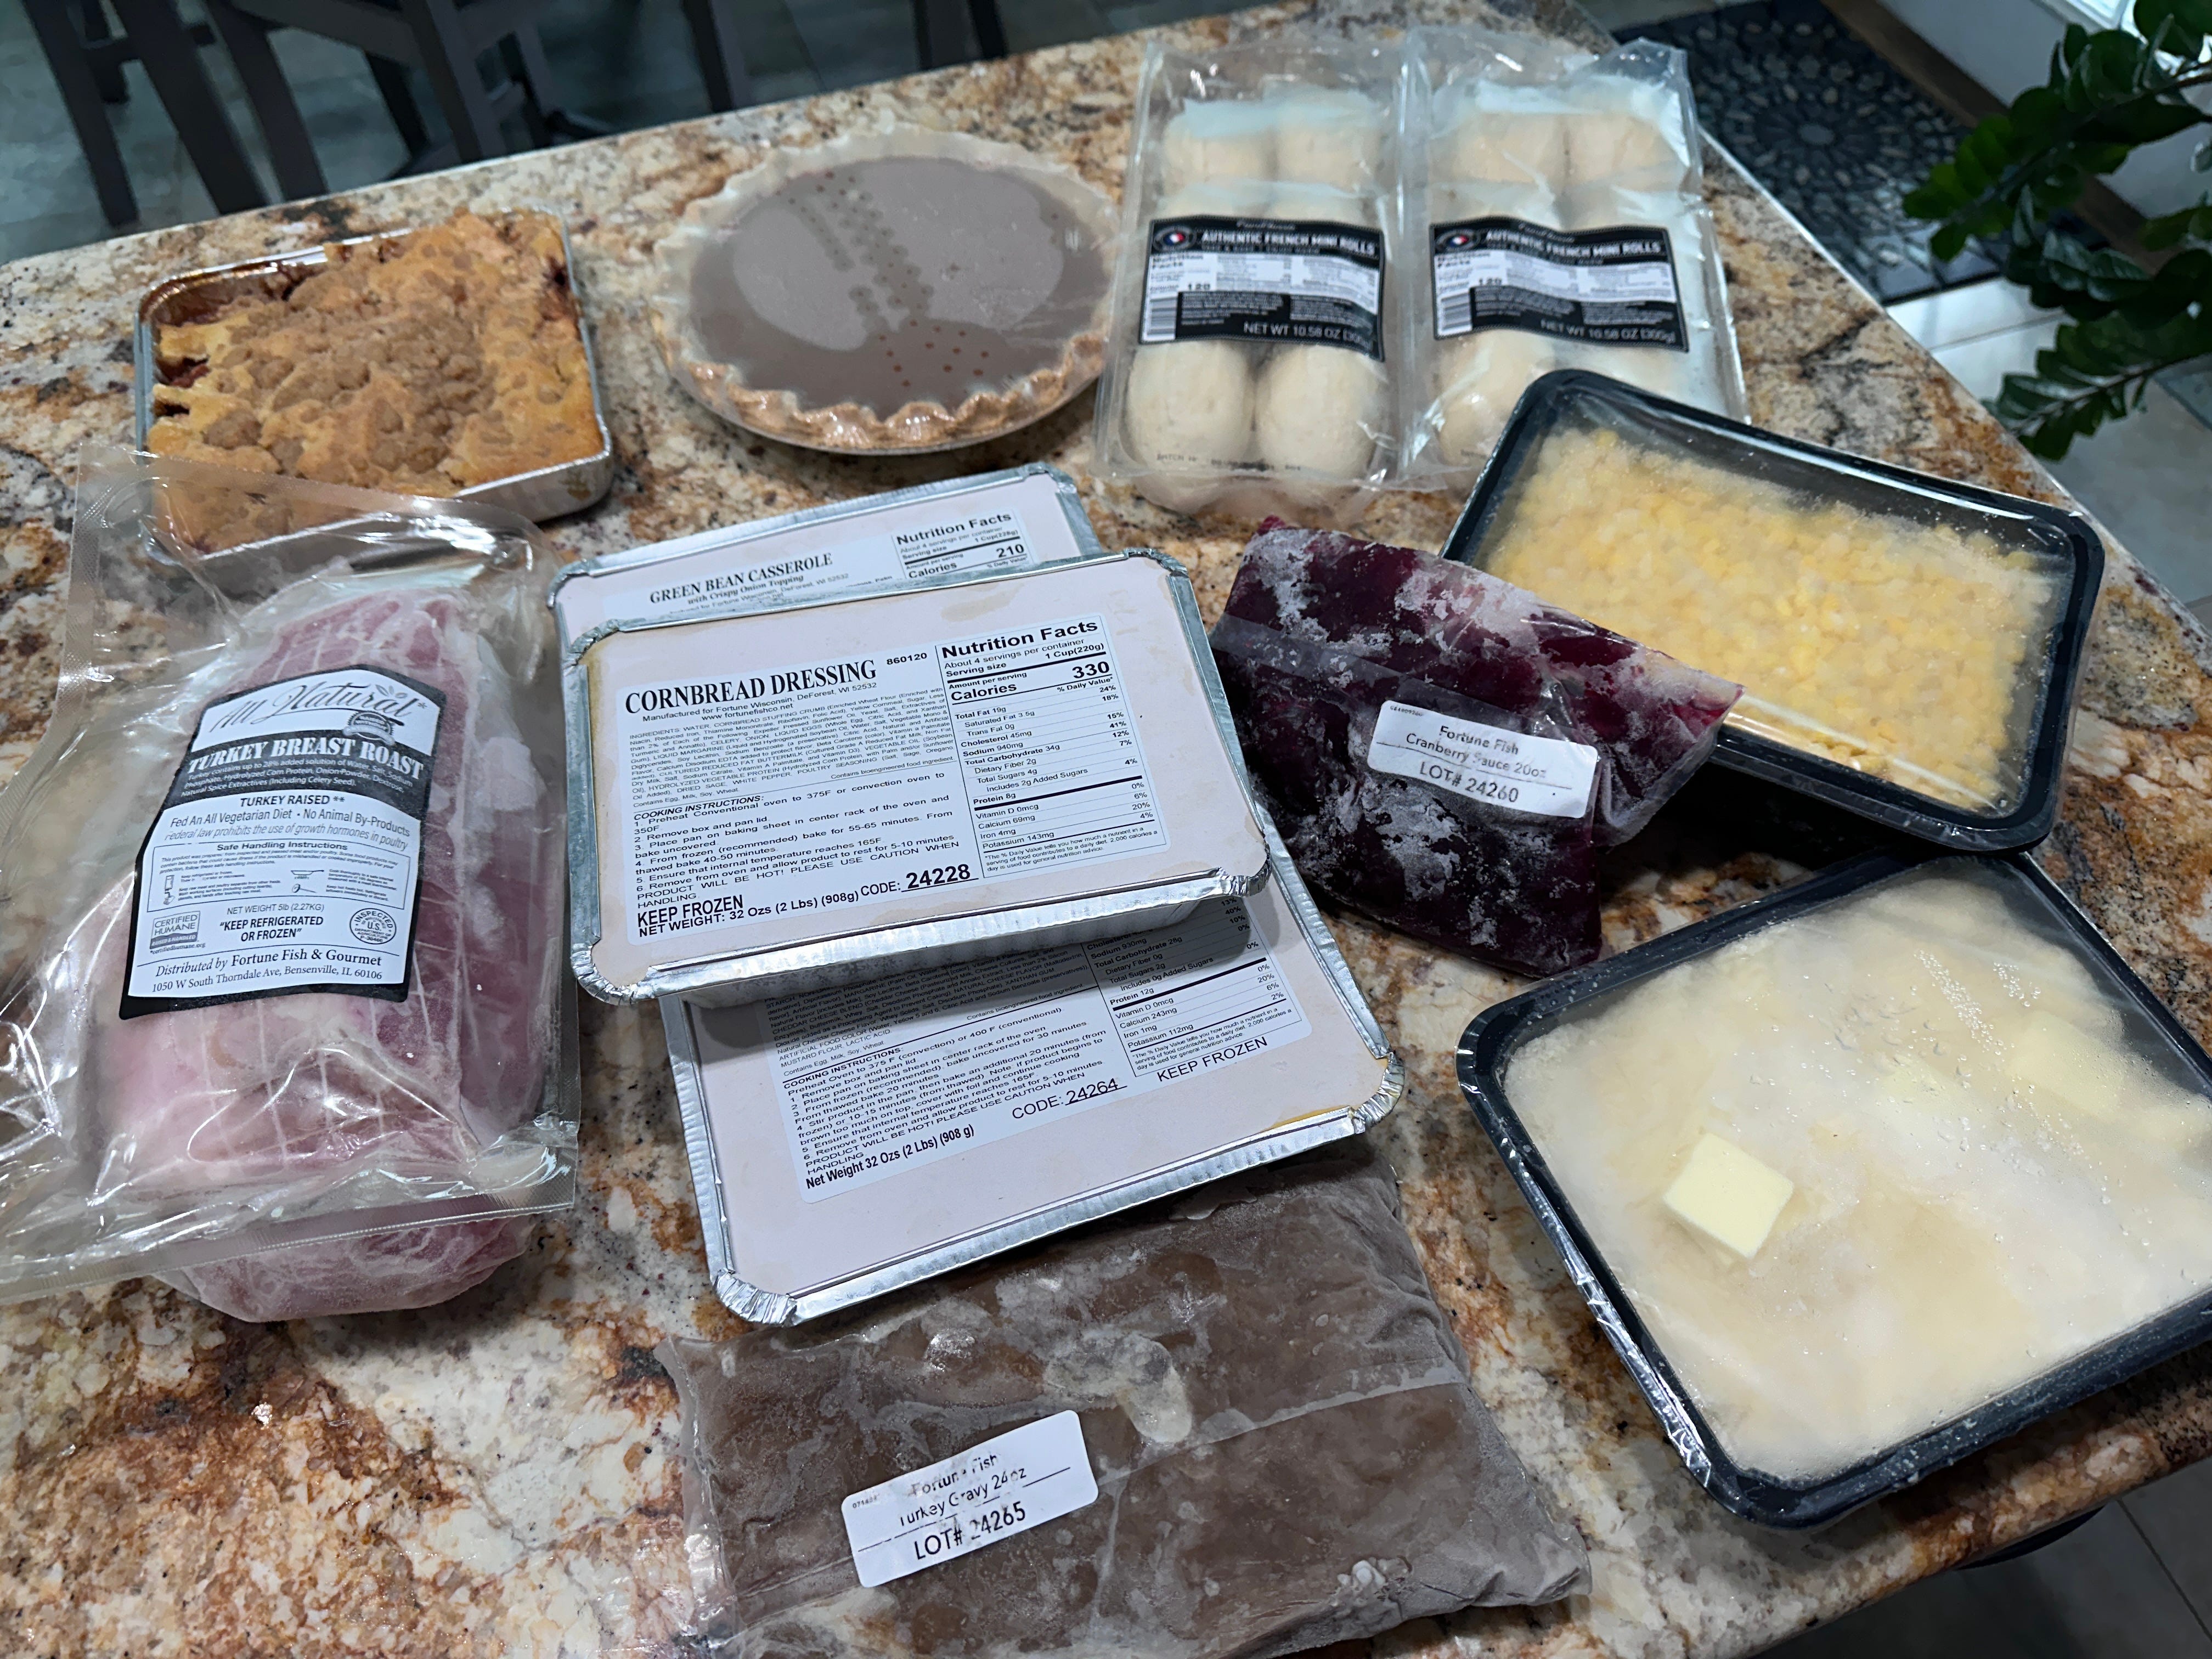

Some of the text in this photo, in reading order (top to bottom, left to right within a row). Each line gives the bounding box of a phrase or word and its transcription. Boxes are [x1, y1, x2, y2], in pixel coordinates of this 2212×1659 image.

[1244, 321, 1268, 335] NET
[1270, 323, 1290, 336] WT
[1324, 326, 1341, 339] OZ
[1541, 318, 1564, 333] NET
[1621, 328, 1639, 340] OZ
[896, 514, 1011, 545] Nutrition Facts
[902, 549, 931, 560] Serving
[996, 544, 1024, 558] 210
[650, 583, 700, 603] GREEN
[705, 573, 743, 591] BEAN
[748, 553, 832, 582] CASSEROLE
[908, 562, 957, 578] Calories
[687, 575, 804, 605] with Crispy Onion Topping
[941, 622, 1098, 658] Nutrition Facts
[1053, 642, 1104, 657] Cup(220g)
[886, 652, 927, 665] 860120
[1071, 661, 1109, 679] 330
[945, 667, 984, 677] Serving
[625, 659, 876, 714] CORNBREAD DRESSING
[950, 684, 1017, 701] Calories
[642, 708, 700, 721] Manufactured
[851, 682, 877, 691] 52532
[210, 699, 268, 732] All
[954, 711, 975, 719] Total
[962, 742, 1023, 757] Sodium 940mg
[1406, 732, 1469, 763] Cranberry
[1438, 725, 1518, 755] Fortune Fish
[188, 737, 424, 780] TURKEY BREAST ROAST
[1419, 761, 1519, 802] LOT# 24260
[240, 795, 286, 807] TURKEY
[287, 794, 330, 804] RAISED
[634, 795, 764, 820] COOKING INSTRUCTIONS:
[973, 795, 1003, 805] Protein
[170, 808, 410, 837] Fed An All Vegetarian Diet No Animal By-Products
[647, 830, 689, 840] Remove
[712, 821, 731, 830] and
[734, 819, 753, 827] pan
[197, 828, 213, 838] law
[212, 825, 252, 838] prohibits
[252, 824, 267, 834] the
[267, 825, 284, 833] use
[285, 822, 295, 834] of
[294, 822, 326, 836] growth
[326, 823, 370, 839] hormones
[369, 830, 379, 842] in
[378, 835, 409, 851] poultry
[287, 841, 348, 850] Instructions
[860, 881, 901, 896] CODE:
[905, 864, 970, 889] 24228
[227, 906, 244, 915] NET
[245, 903, 277, 913] WEIGHT
[290, 902, 324, 912] (2.27KG)
[354, 911, 393, 928] INSPECTED
[637, 894, 743, 927] KEEP FROZEN
[639, 890, 859, 938] NET WEIGHT: 32 Ozs (2 Lbs) (908g)
[155, 915, 198, 928] CERTIFIED
[155, 922, 196, 935] HUMANE
[240, 928, 302, 941] OR FROZEN”
[155, 948, 382, 977] Distributed by Fortune Fish & Gourmet
[151, 964, 382, 992] 1050 W South Thorndale Ave, Bensenville, IL 60106
[1109, 993, 1138, 1005] Protein
[783, 1047, 902, 1089] COOKING INSTRUCTIONS:
[1156, 1036, 1267, 1082] KEEP FROZEN
[1068, 1079, 1118, 1104] 24264
[1012, 1095, 1064, 1119] CODE:
[805, 1124, 974, 1189] Net Weight 32 Ozs (2 Lbs) (908 g)
[949, 1482, 988, 1506] Gravy
[915, 1527, 963, 1560] LOT#
